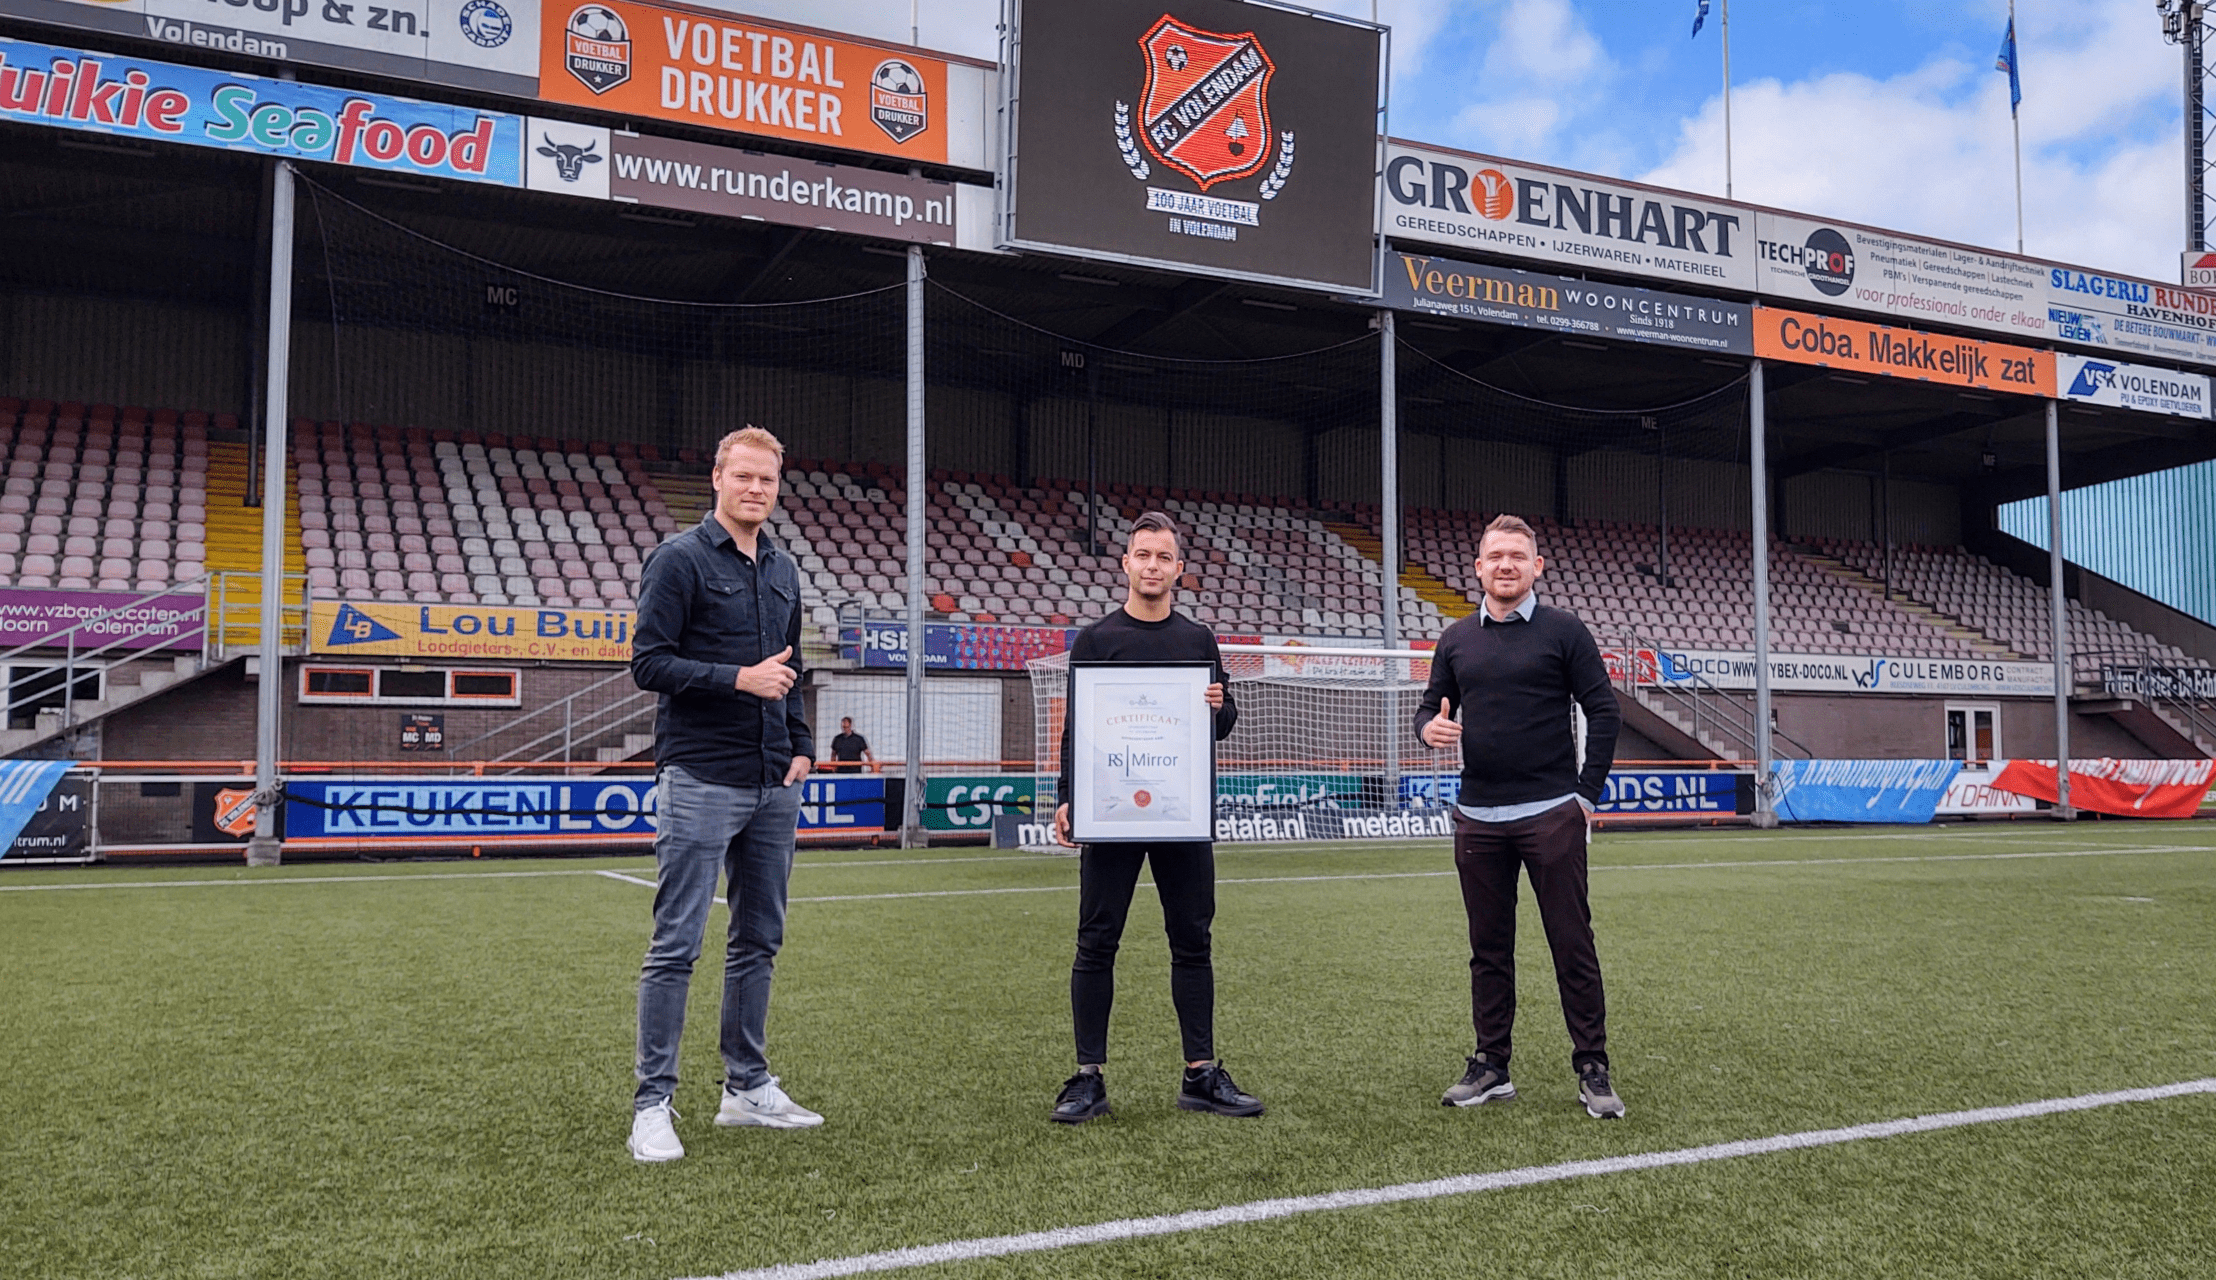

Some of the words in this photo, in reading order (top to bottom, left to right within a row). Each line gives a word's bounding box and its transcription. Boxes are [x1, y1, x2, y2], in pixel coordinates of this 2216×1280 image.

[367, 6, 429, 37] zn.
[146, 16, 287, 59] Volendam
[574, 40, 622, 59] VOETBAL
[663, 16, 844, 88] VOETBAL
[574, 57, 623, 75] DRUKKER
[661, 66, 842, 136] DRUKKER
[878, 93, 920, 111] VOETBAL
[1150, 118, 1179, 150] FC
[1172, 48, 1263, 129] VOLENDAM
[0, 53, 189, 133] uikie
[206, 86, 495, 173] Seafood
[878, 109, 920, 126] DRUKKER
[614, 152, 953, 226] www.runderkamp.nl
[1154, 192, 1176, 209] 100
[1177, 196, 1204, 215] JAAR
[1208, 201, 1252, 222] VOETBAL
[1169, 218, 1182, 233] IN
[1183, 219, 1237, 241] VOLENDAM
[1396, 214, 1536, 249] GEREEDSCHAPPEN
[1553, 239, 1641, 266] IJZERWAREN
[1654, 257, 1726, 279] MATERIEEL
[1856, 233, 1948, 259] Bevestigingsmaterialen
[1979, 256, 1984, 265] &
[1986, 257, 2045, 277] Aandrijftechniek
[1770, 266, 1805, 278] TECHNISCHE
[1870, 251, 1917, 268] Pneumatiek
[1923, 260, 1986, 280] Gereedschappen
[1991, 271, 2034, 289] Lastechniek
[487, 286, 518, 306] MC
[1401, 256, 1560, 312] Veerman
[1565, 289, 1738, 327] WOONCENTRUM
[1912, 273, 1961, 290] Verspanende
[1963, 284, 2024, 301] gereedschappen
[2051, 268, 2149, 303] SLAGERIJ
[1629, 314, 1652, 327] Sinds
[1654, 317, 1675, 329] 1918
[1855, 287, 1884, 303] voor
[1887, 292, 1967, 317] professionals
[1971, 306, 2006, 322] onder
[2011, 311, 2045, 329] elkaar
[1413, 297, 1458, 313] Julianaweg
[1460, 303, 1476, 315] 151,
[1478, 306, 1519, 321] Volendam
[1536, 314, 1549, 325] tel.
[1550, 316, 1600, 331] 0299-366788
[1616, 326, 1728, 348] www.veerman-wooncentrum.nl
[2114, 319, 2124, 331] DE
[2125, 320, 2152, 337] BETERE
[2153, 324, 2201, 345] BOUWMARKT
[1061, 351, 1085, 369] MD
[1780, 317, 1860, 360] Coba.
[1869, 331, 1989, 384] Makkelijk
[2001, 356, 2036, 384] zat
[2120, 374, 2202, 401] VOLENDAM
[2121, 393, 2130, 403] PU
[2138, 395, 2158, 407] EPOXY
[1641, 416, 1658, 430] ME
[420, 606, 515, 635] Lou
[537, 611, 636, 643] Buij
[571, 646, 590, 656] en
[888, 653, 947, 663] VOLDAM
[1889, 662, 2004, 681] CULEMBORG
[1106, 714, 1180, 726] CERTIFICAAT
[402, 731, 420, 743] MC
[424, 731, 442, 743] MD
[1108, 753, 1123, 767] RS
[1132, 753, 1178, 767] Mirror
[1216, 813, 1306, 839] etafa.nl
[1343, 810, 1451, 837] metafa.nl
